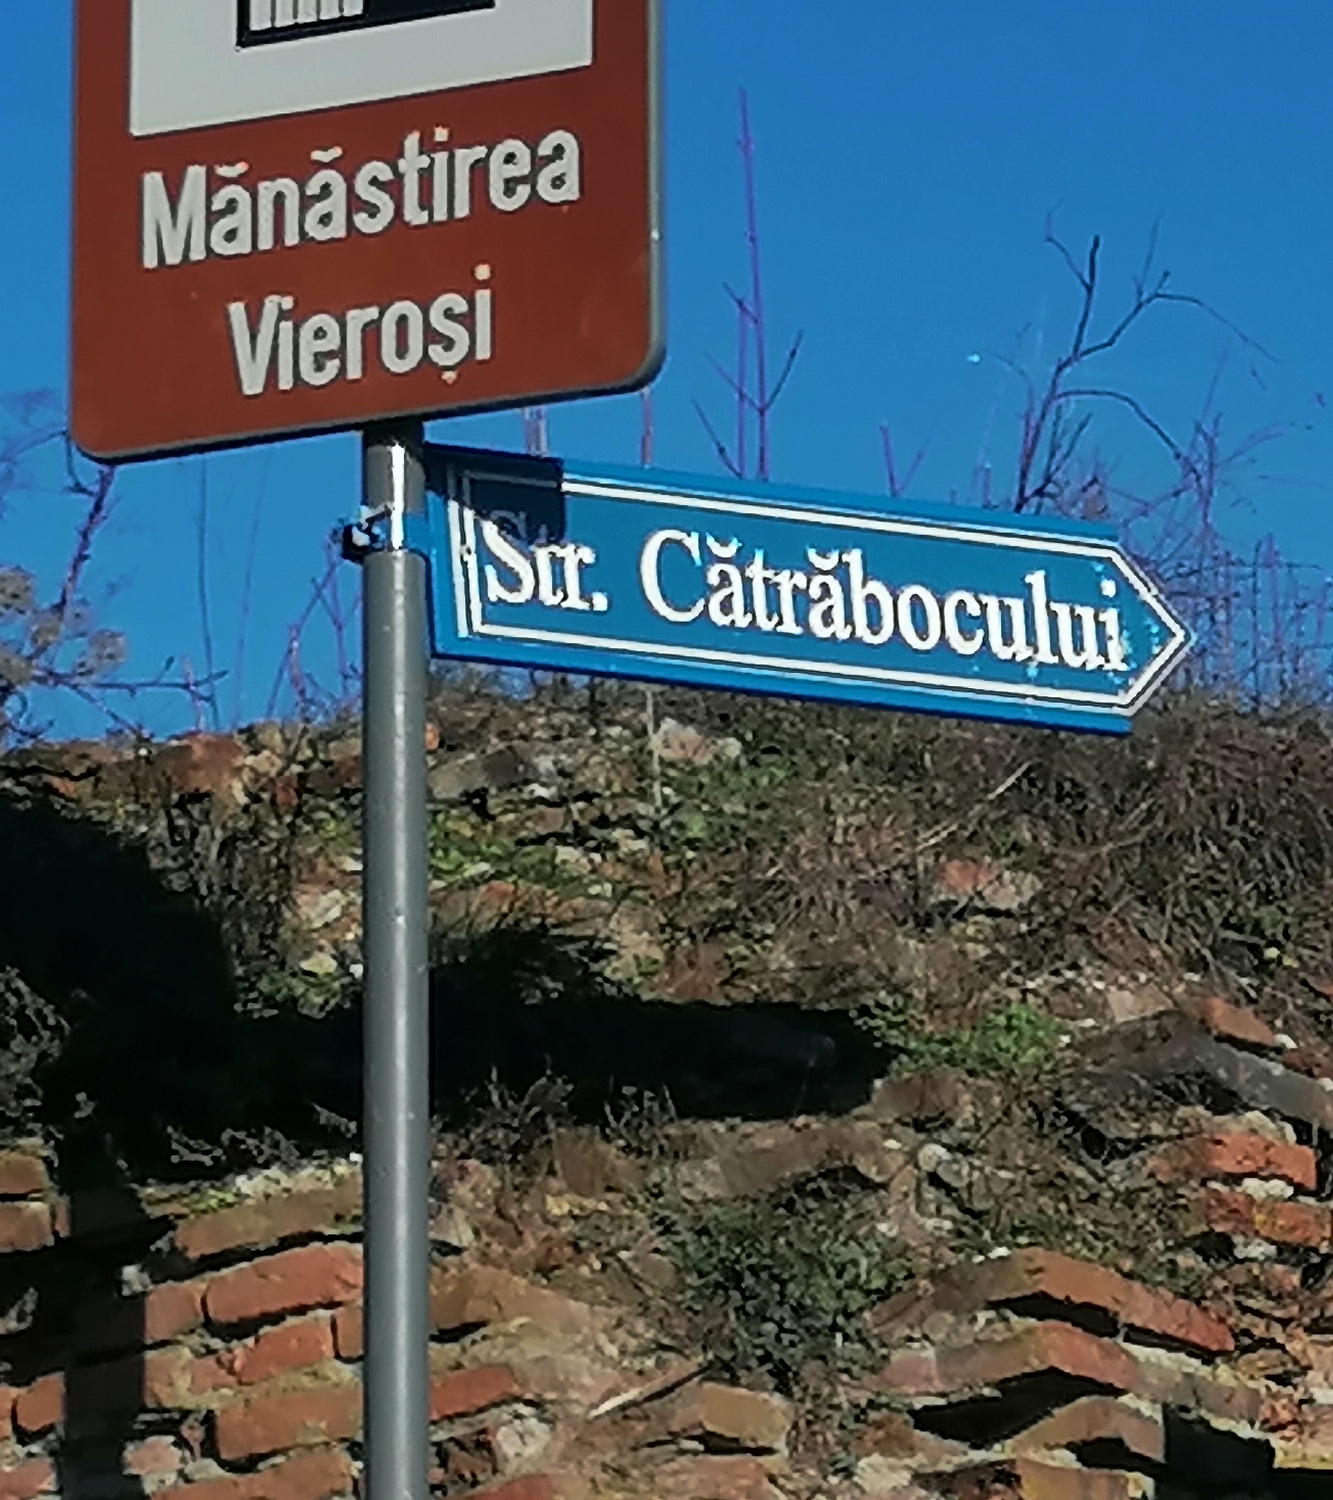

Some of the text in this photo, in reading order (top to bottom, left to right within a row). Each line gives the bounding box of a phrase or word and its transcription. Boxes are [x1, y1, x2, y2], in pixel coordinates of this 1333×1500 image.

[141, 126, 581, 270] Mănăstirea
[227, 263, 493, 395] Vieroși
[481, 508, 1131, 673] Str. Cătrăbocului
